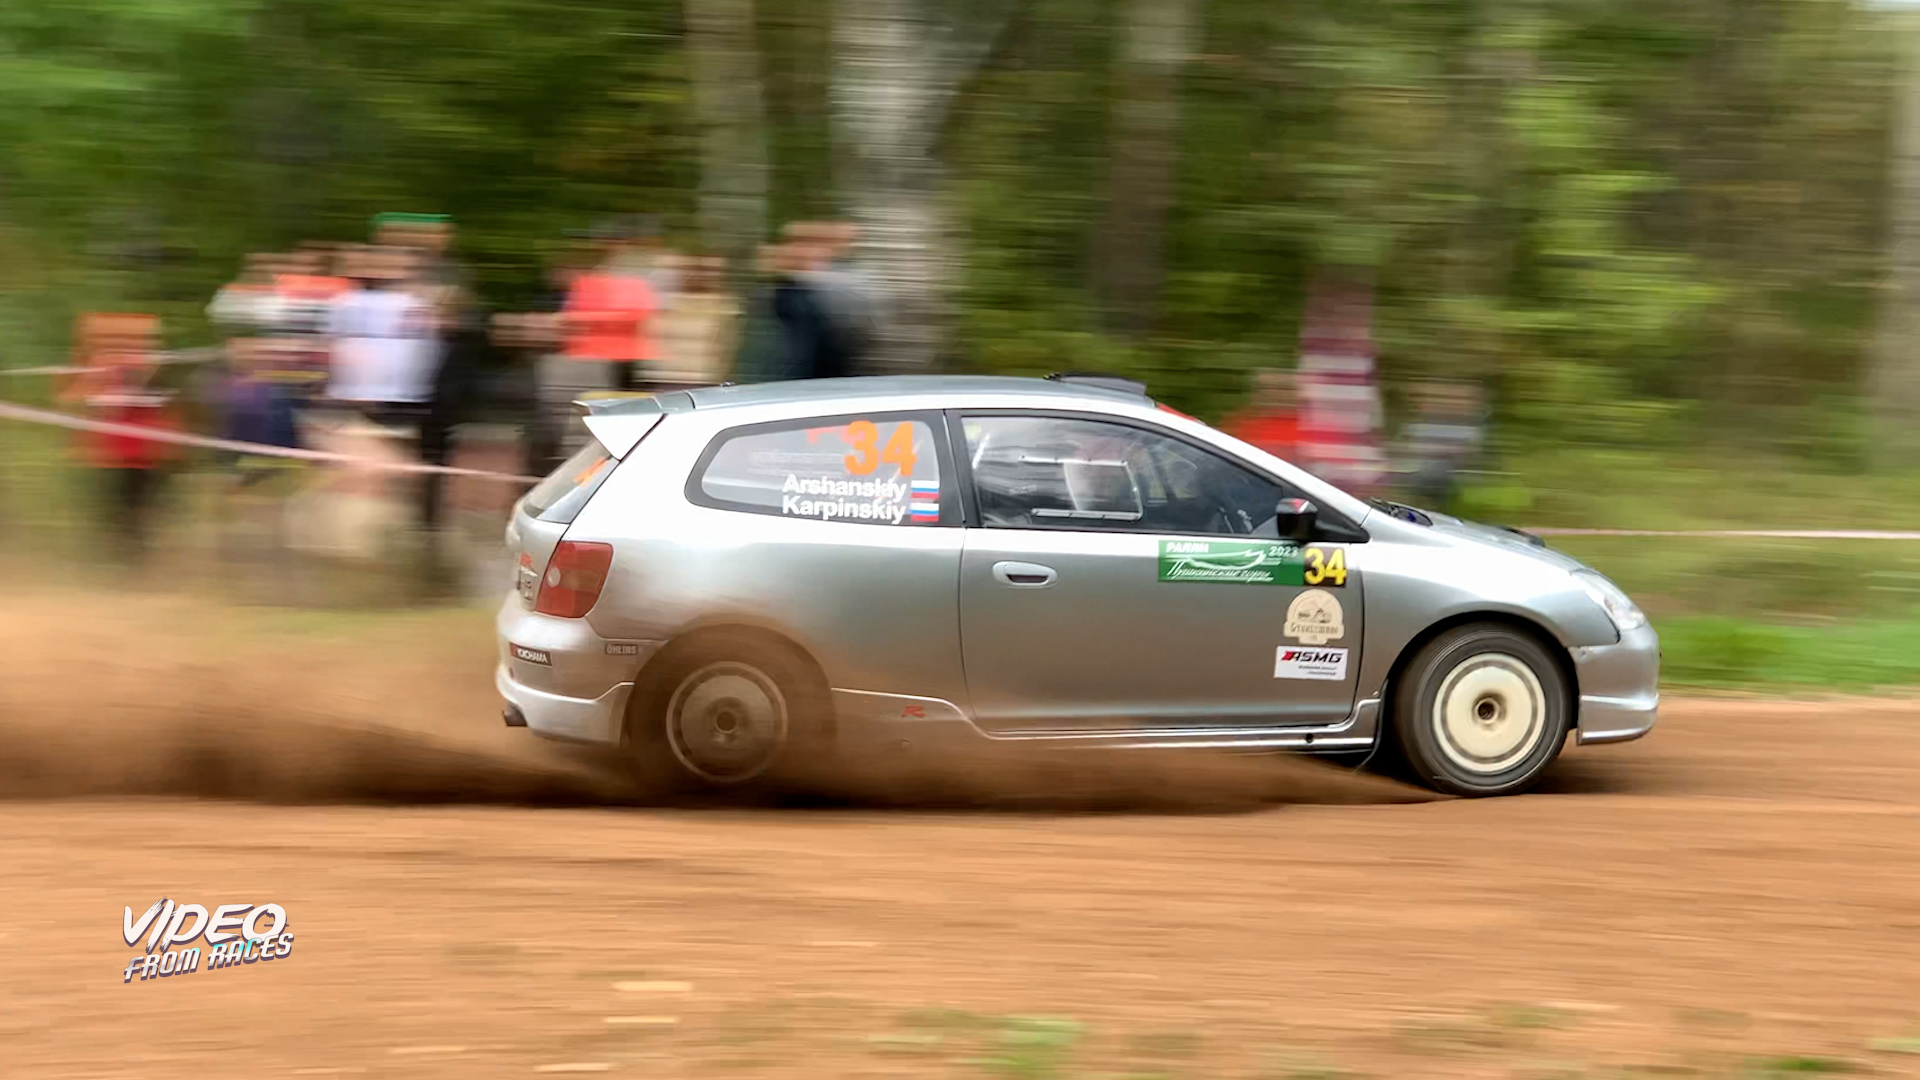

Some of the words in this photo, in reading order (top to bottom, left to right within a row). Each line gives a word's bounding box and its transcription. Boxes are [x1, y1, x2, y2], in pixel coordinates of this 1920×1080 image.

[844, 420, 918, 477] 34
[782, 474, 907, 503] Arshanskiy
[782, 495, 907, 525] Karpinskiy
[1268, 546, 1299, 558] 2023
[1304, 547, 1347, 585] 34
